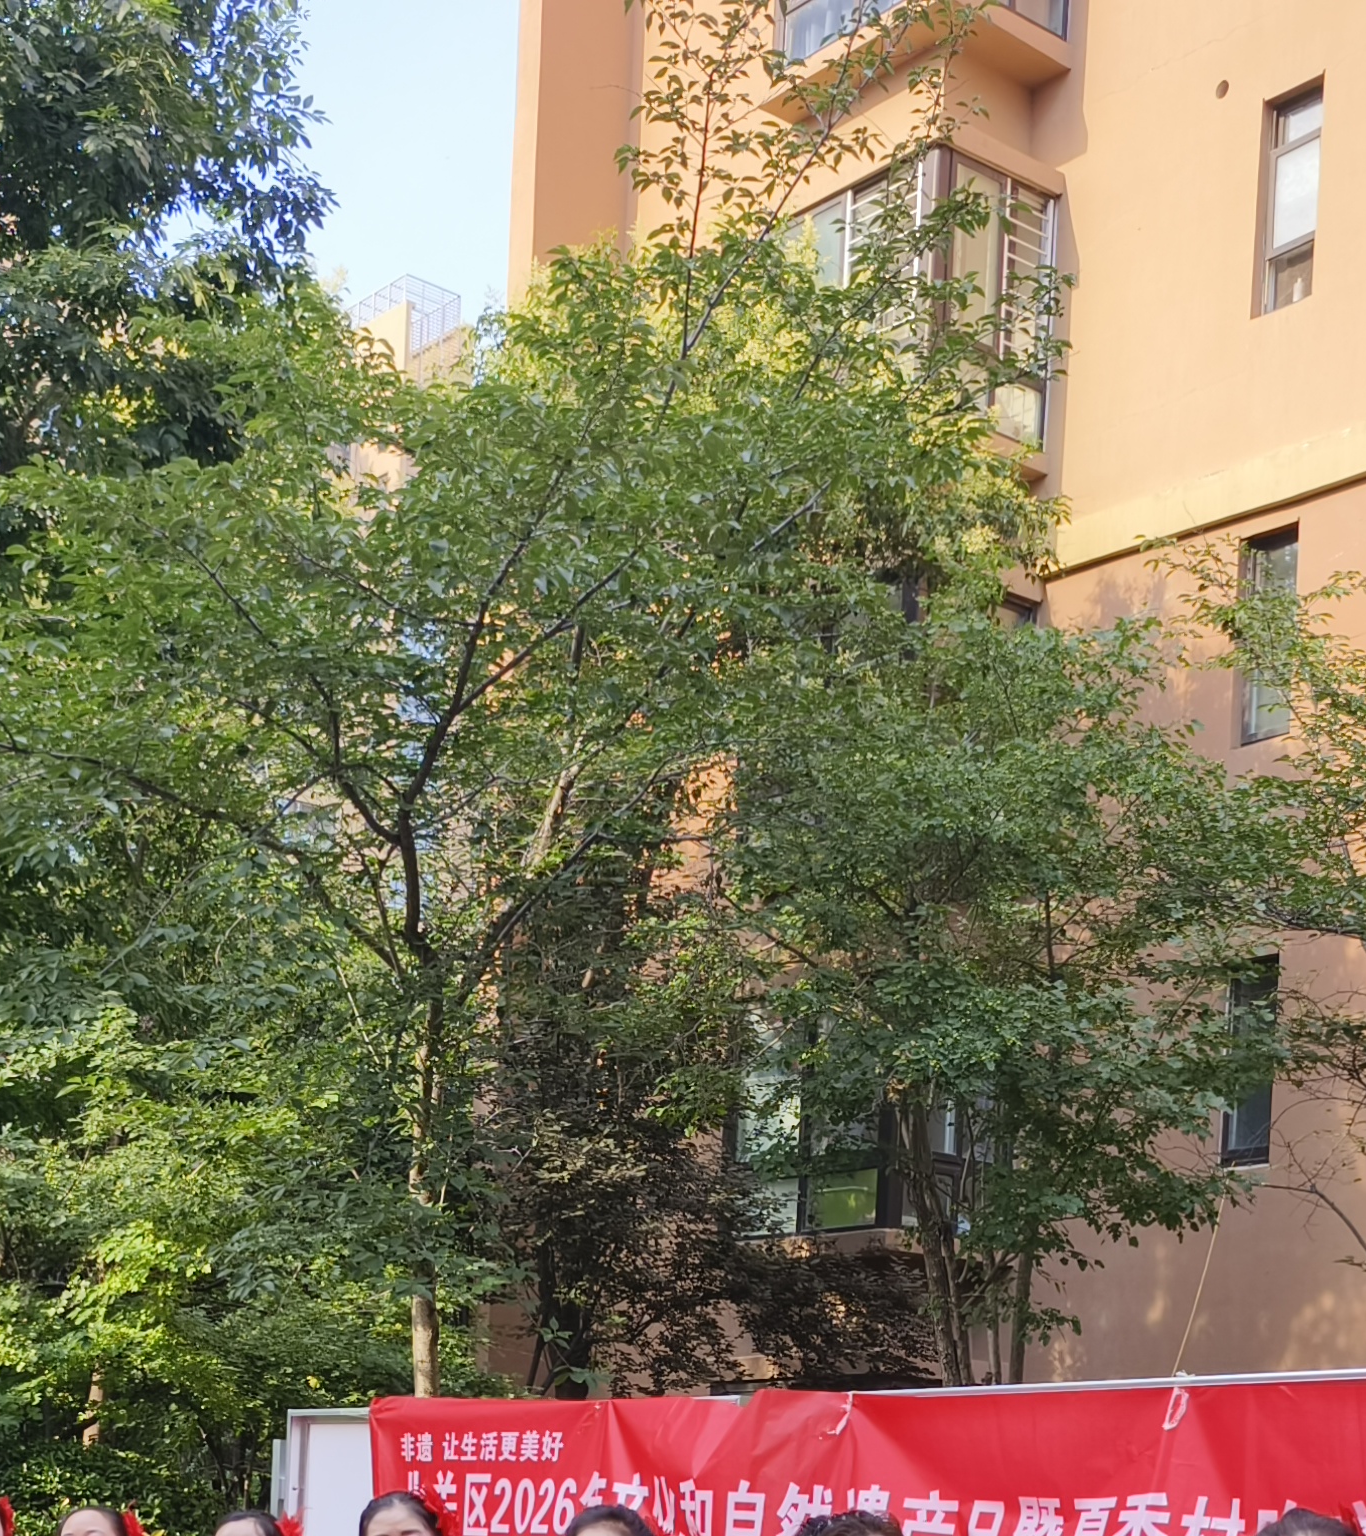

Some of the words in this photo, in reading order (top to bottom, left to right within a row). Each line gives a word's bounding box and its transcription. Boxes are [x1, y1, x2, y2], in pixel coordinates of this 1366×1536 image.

[400, 1432, 434, 1463] 非遗
[442, 1430, 565, 1463] 让生活更美好
